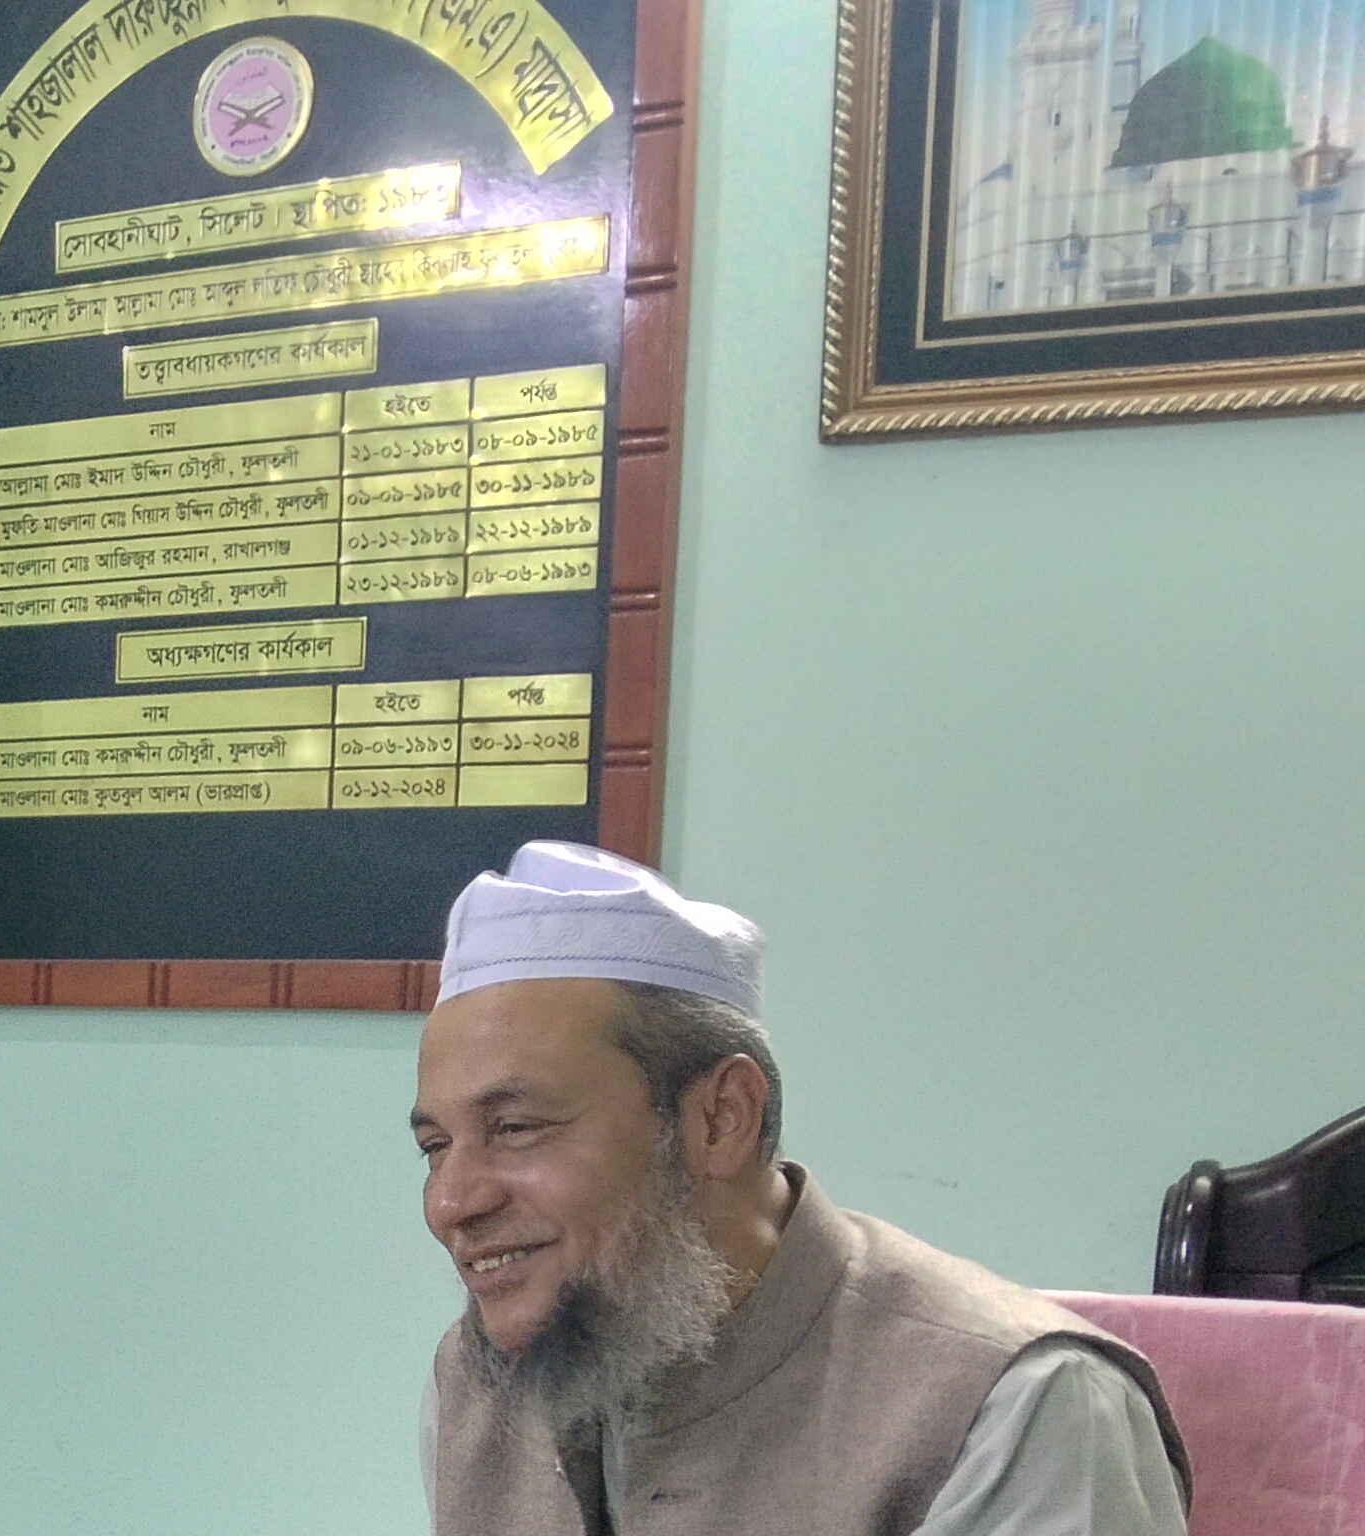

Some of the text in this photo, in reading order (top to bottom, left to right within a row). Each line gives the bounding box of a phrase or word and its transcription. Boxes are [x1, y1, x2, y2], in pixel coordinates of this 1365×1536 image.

[0, 22, 111, 140] শাহজালাল
[512, 36, 595, 149] মাদ্রাসা
[12, 304, 59, 331] শামসুল
[113, 290, 163, 319] আল্লামা
[289, 331, 367, 362] কার্যকাল
[150, 421, 176, 438] নাম
[383, 395, 432, 418] হইতে
[520, 378, 557, 403] পর্যন্ত
[0, 474, 48, 496] আল্লামা
[54, 471, 81, 491] মোঃ
[88, 465, 125, 486] ইমাদ
[241, 446, 298, 475] ফুলতলী
[351, 437, 465, 462] ২১-০১-১৯৮৩
[476, 423, 599, 450] ০৮-০৯-১৯৮৫
[1, 514, 38, 541] মুফতি
[43, 513, 95, 533] মাওলানা
[101, 510, 126, 530] মোঃ
[276, 486, 329, 518] ফুলতলী
[347, 482, 462, 507] ০৯-০৯-১৯৮৫
[475, 469, 595, 495] ৩০-১১-১৯৮৯
[0, 557, 55, 578] মাওলানা
[62, 554, 89, 573] মোঃ
[95, 547, 155, 572] আজিজুর
[348, 526, 459, 550] ০১-১২-১৯৮৯
[475, 516, 592, 542] ২২-১২-১৯৮৯
[0, 598, 55, 618] মাওলানা
[61, 596, 88, 615] মোঃ
[230, 575, 288, 605] ফুলতলী
[347, 569, 459, 592] ২৩-১২-১৯৮৯
[473, 561, 591, 584] ০৮-০৬-১৯৯৩
[146, 632, 334, 667] অধ্যক্ষগণের কার্যকাল
[142, 706, 170, 723] নাম
[374, 691, 421, 712] হইতে
[507, 681, 545, 707] পর্যন্ত
[0, 750, 57, 769] মাওলানা
[62, 748, 89, 767] মোঃ
[229, 735, 287, 766] ফুলতলী
[341, 736, 453, 755] ০৯-০৬-১৯৯৩
[470, 730, 580, 752] ৩০-১১-২০২৪
[0, 790, 56, 808] মাওলানা
[62, 788, 89, 806] মোঃ
[95, 786, 142, 809] কুতবুল
[148, 783, 190, 803] আলম
[196, 779, 271, 807] (ভারপ্রাপ্ত)
[342, 779, 445, 799] ০১-১২-২০২৪
